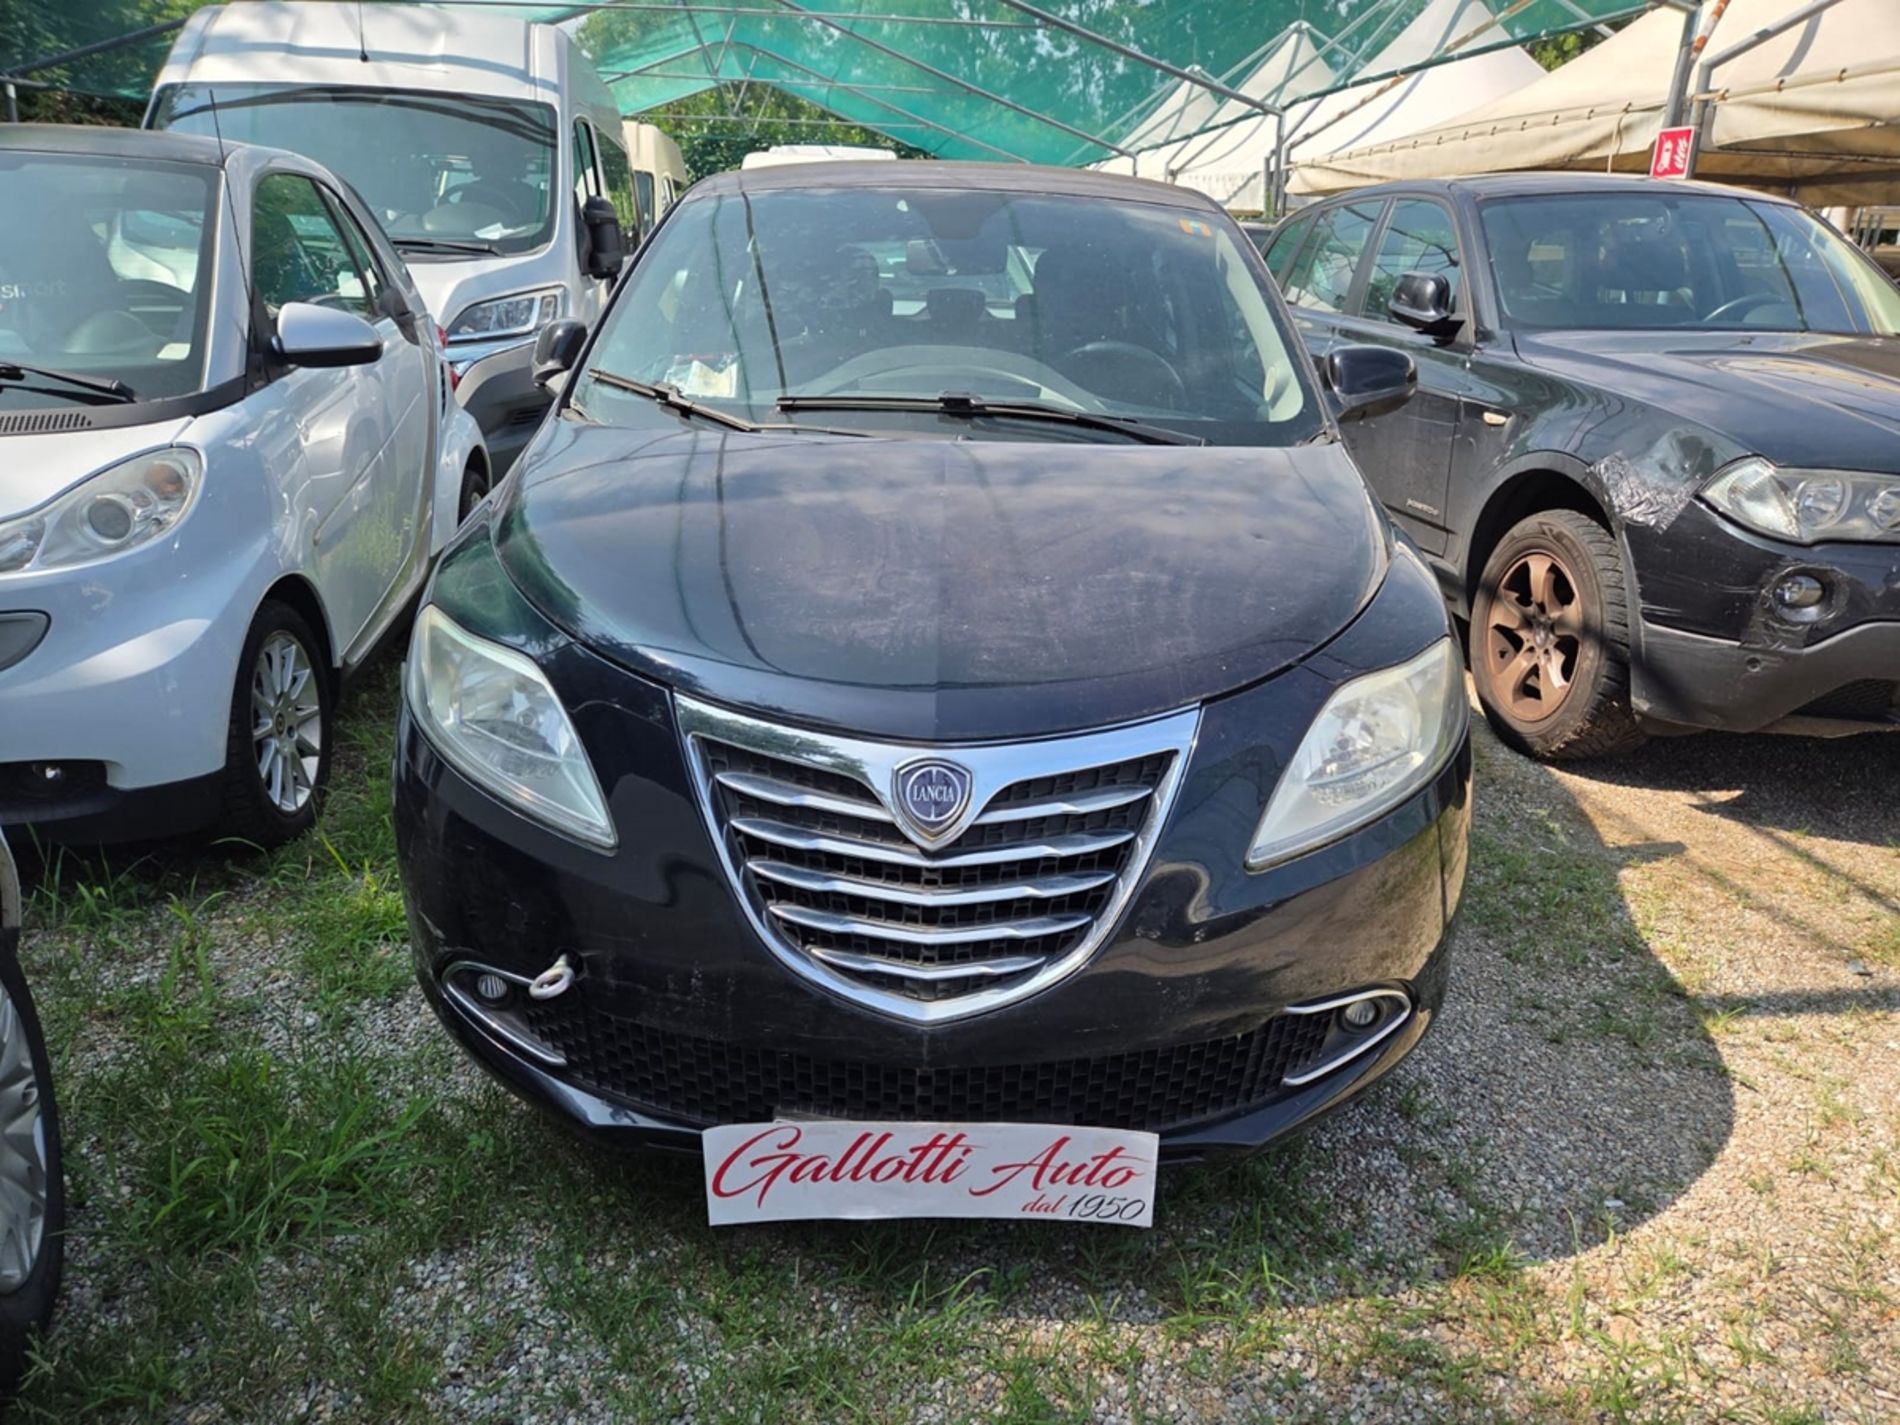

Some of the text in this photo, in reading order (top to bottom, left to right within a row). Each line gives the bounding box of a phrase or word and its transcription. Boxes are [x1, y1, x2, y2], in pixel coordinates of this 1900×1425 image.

[912, 785, 954, 802] LANCIA
[711, 1126, 1150, 1208] Gallotti Auto
[1022, 1193, 1147, 1220] dal 1950
